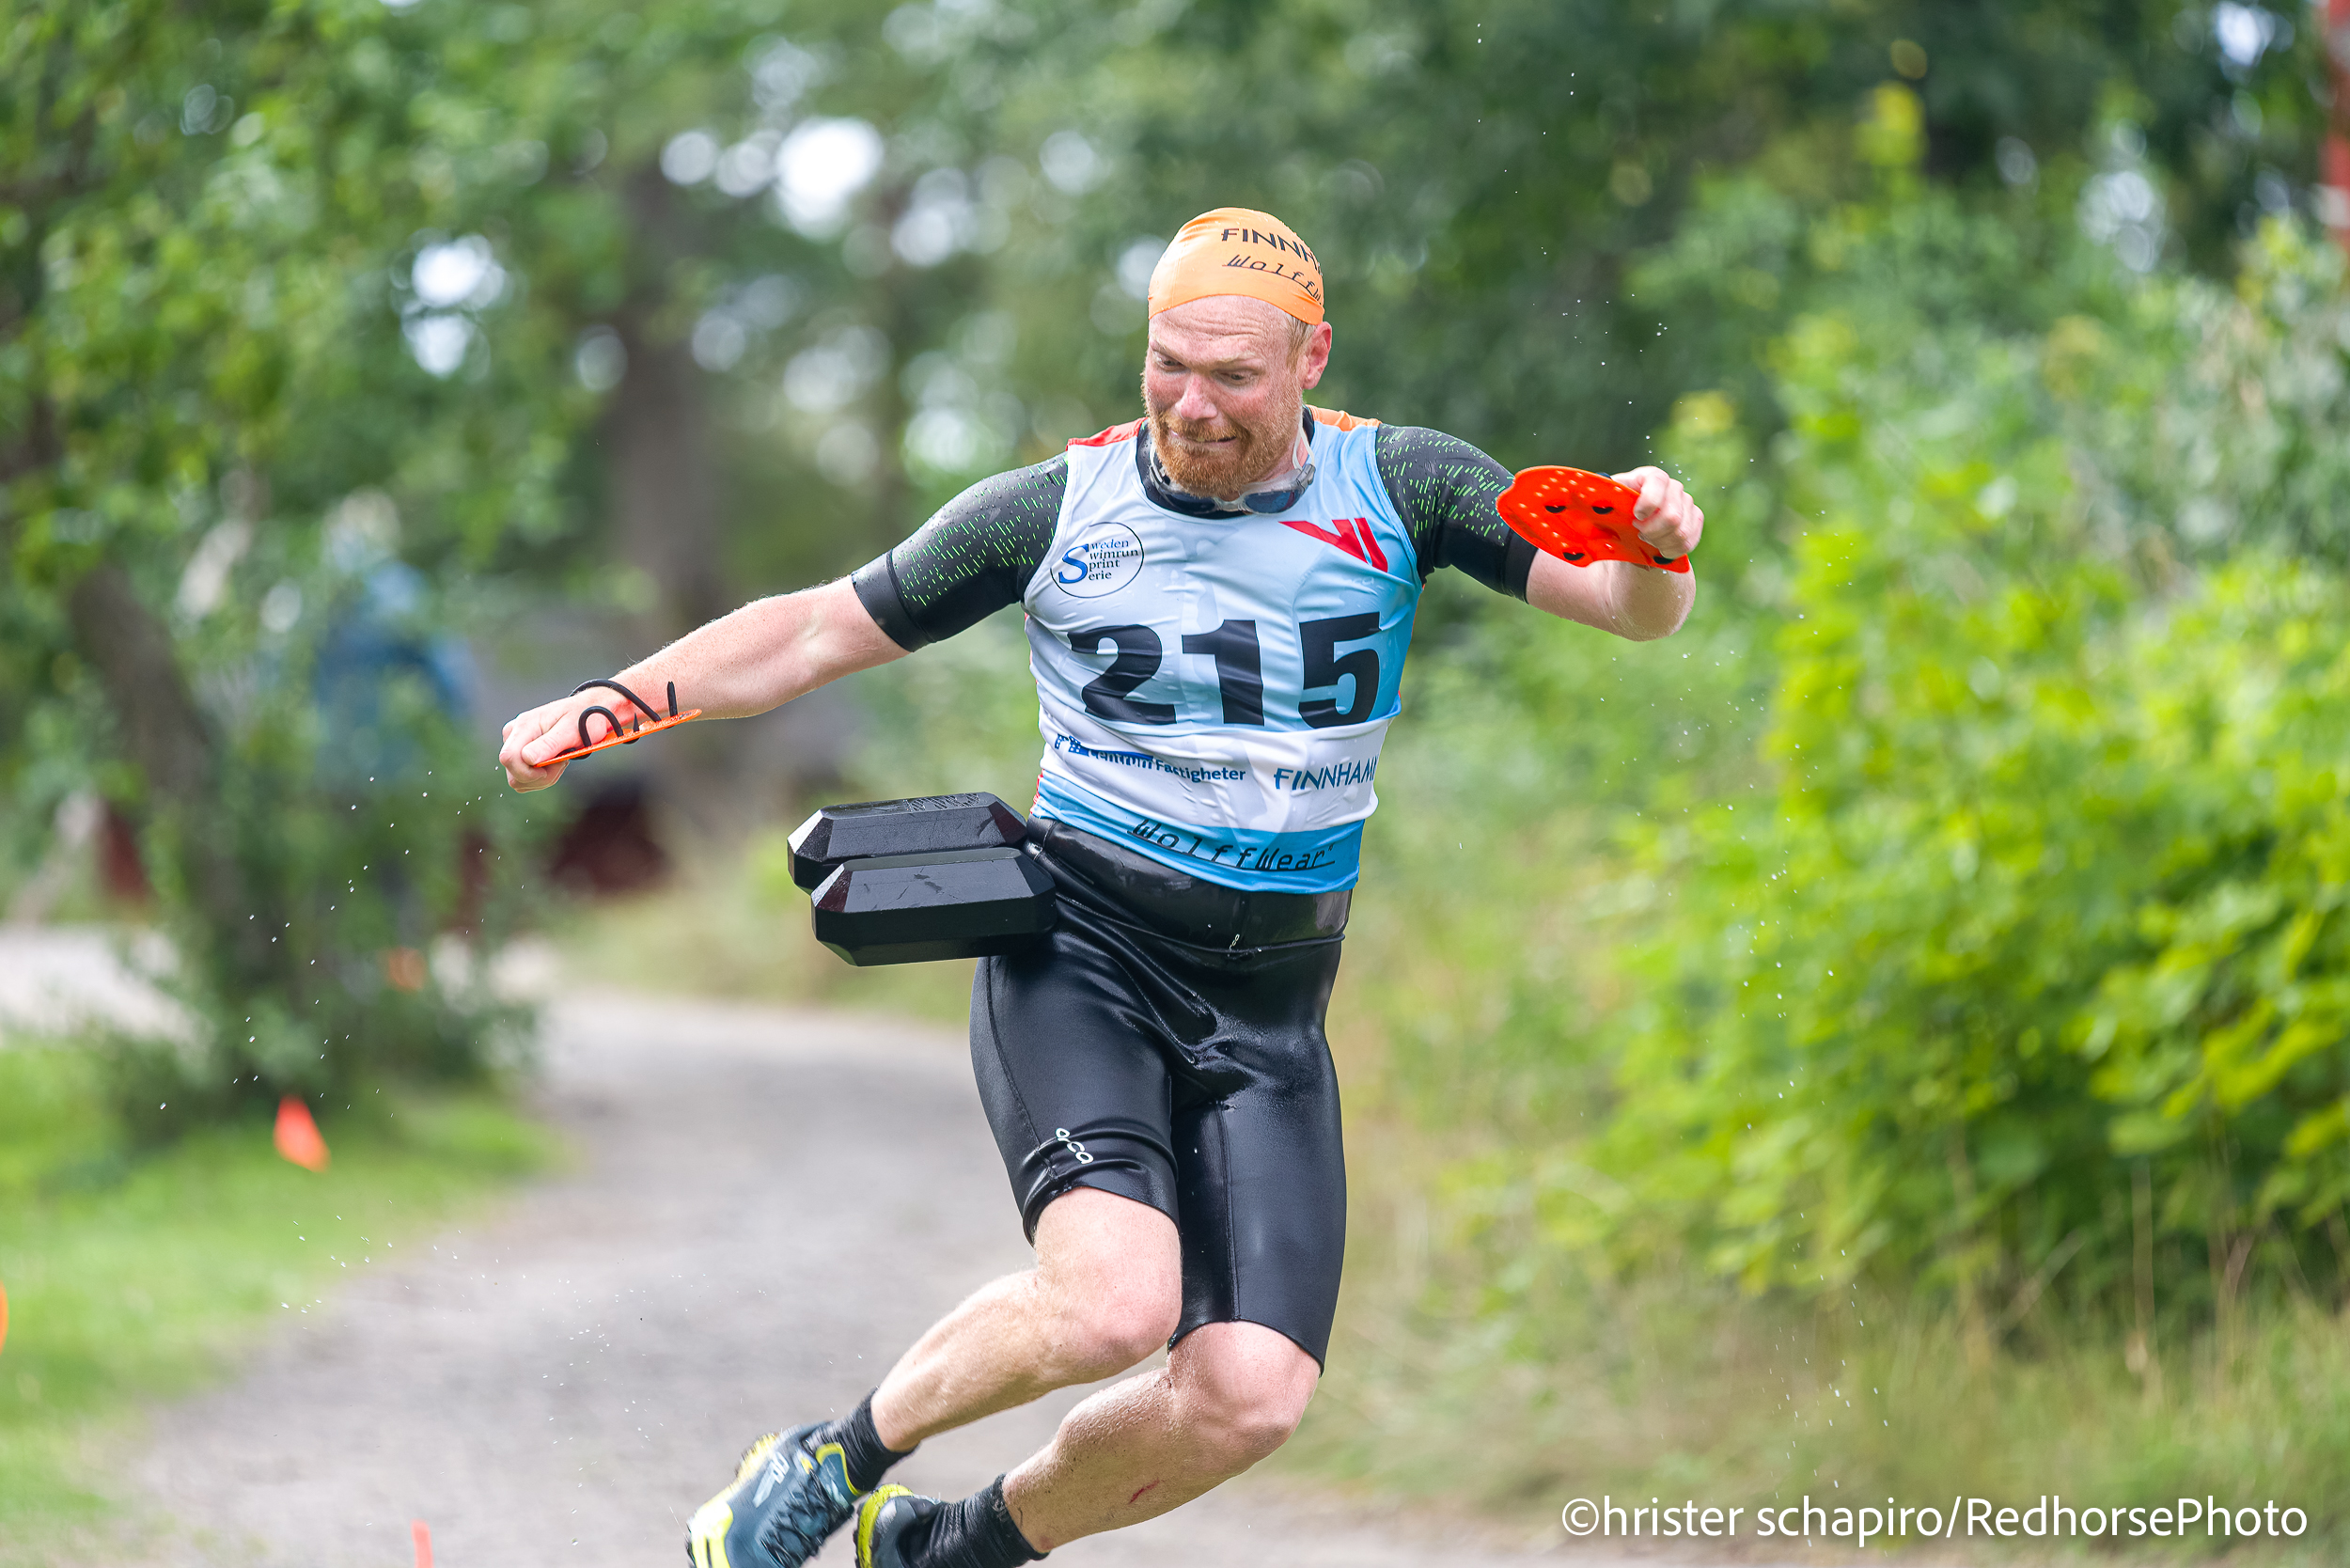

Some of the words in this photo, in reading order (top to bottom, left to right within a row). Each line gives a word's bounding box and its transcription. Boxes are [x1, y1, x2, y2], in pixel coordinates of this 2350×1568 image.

[1221, 227, 1322, 274] FINNH
[1066, 611, 1382, 729] 215
[1155, 759, 1246, 783] Fastigheter
